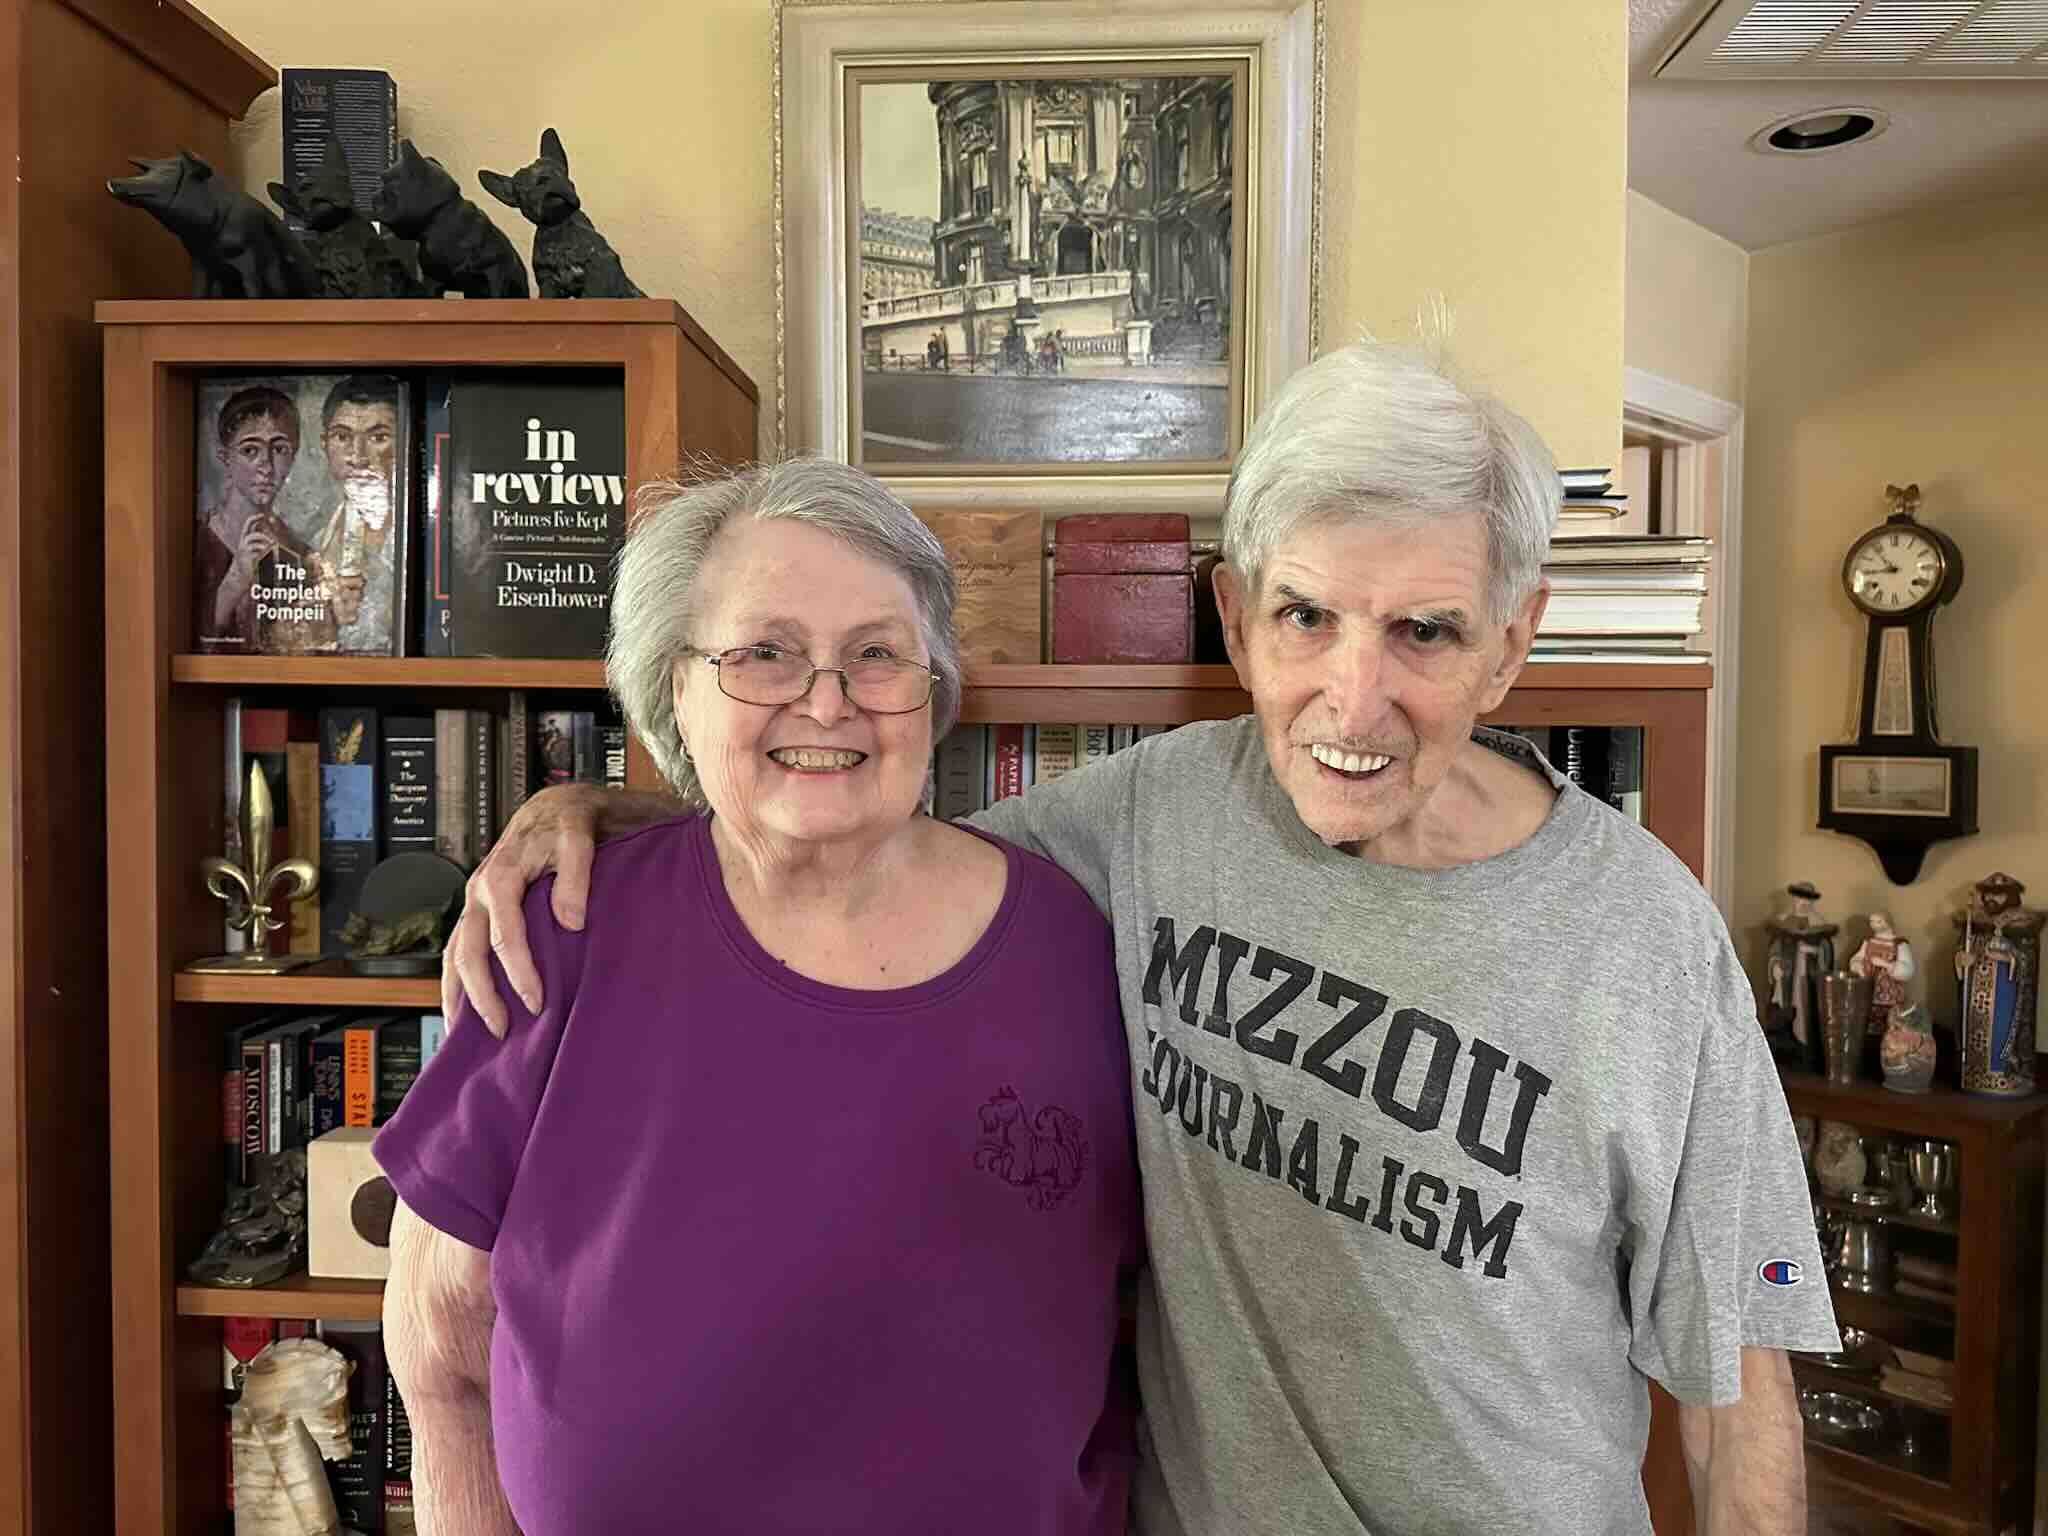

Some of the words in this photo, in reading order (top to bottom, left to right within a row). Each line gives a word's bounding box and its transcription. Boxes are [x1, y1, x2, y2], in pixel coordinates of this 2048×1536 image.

[525, 417, 577, 462] in
[471, 461, 627, 505] review
[492, 509, 551, 528] Pictures
[576, 510, 607, 533] Kept
[274, 563, 307, 580] The
[505, 562, 572, 588] Dwight
[578, 563, 597, 584] D.
[496, 585, 608, 609] Eisenhower
[256, 604, 325, 624] Pompeii
[606, 748, 625, 777] TOM
[1567, 728, 1585, 785] Daniel
[1142, 917, 1552, 1177] MIZZOU
[1142, 1029, 1523, 1280] JOURNALISM
